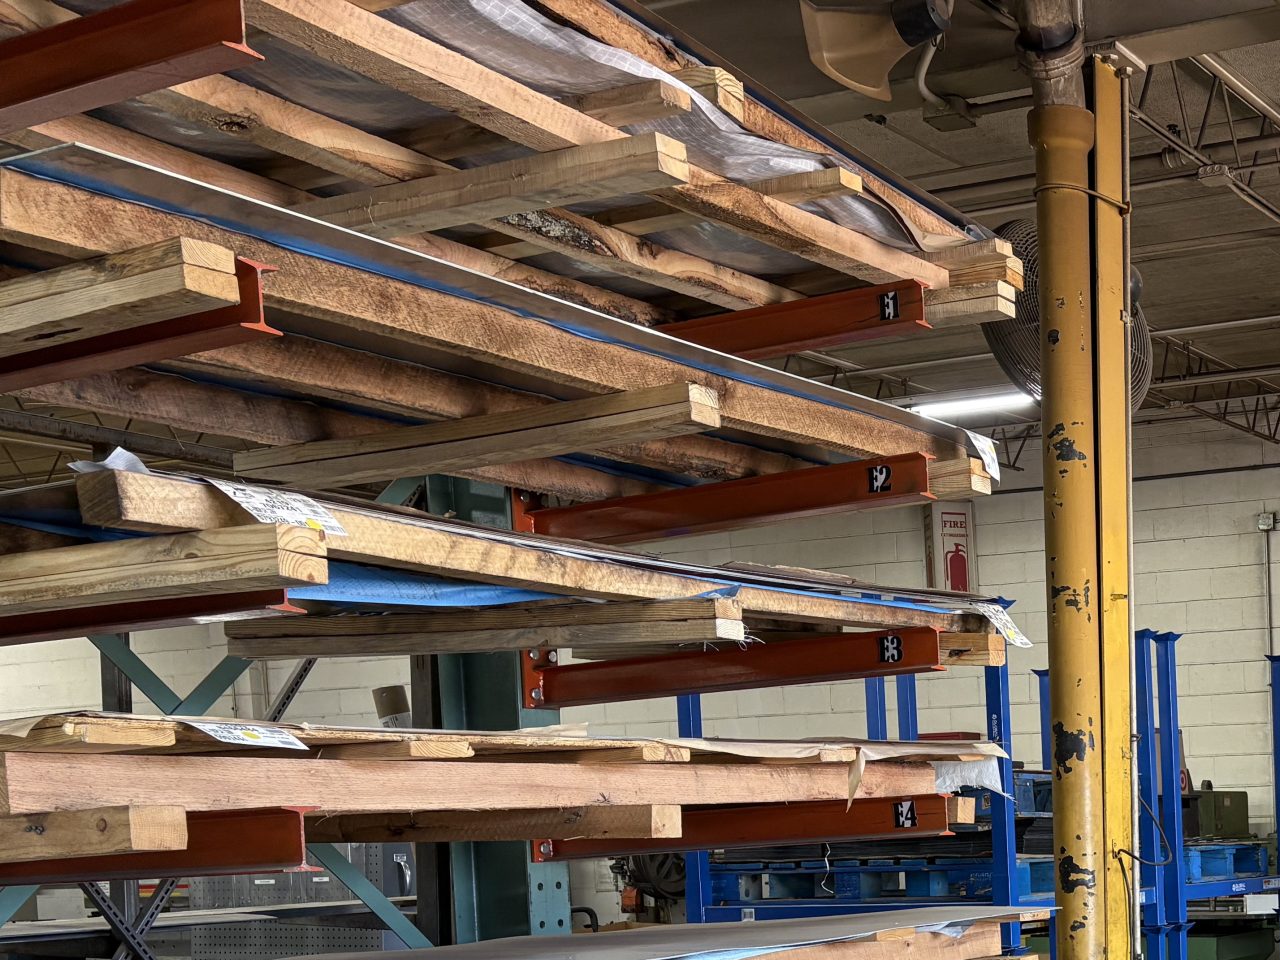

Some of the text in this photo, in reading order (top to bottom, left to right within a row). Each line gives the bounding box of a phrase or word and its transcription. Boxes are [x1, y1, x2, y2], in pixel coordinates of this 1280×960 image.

[879, 290, 899, 320] E1
[868, 465, 892, 493] E2
[943, 520, 966, 528] FIRE
[879, 635, 903, 662] E3
[893, 801, 917, 828] E4
